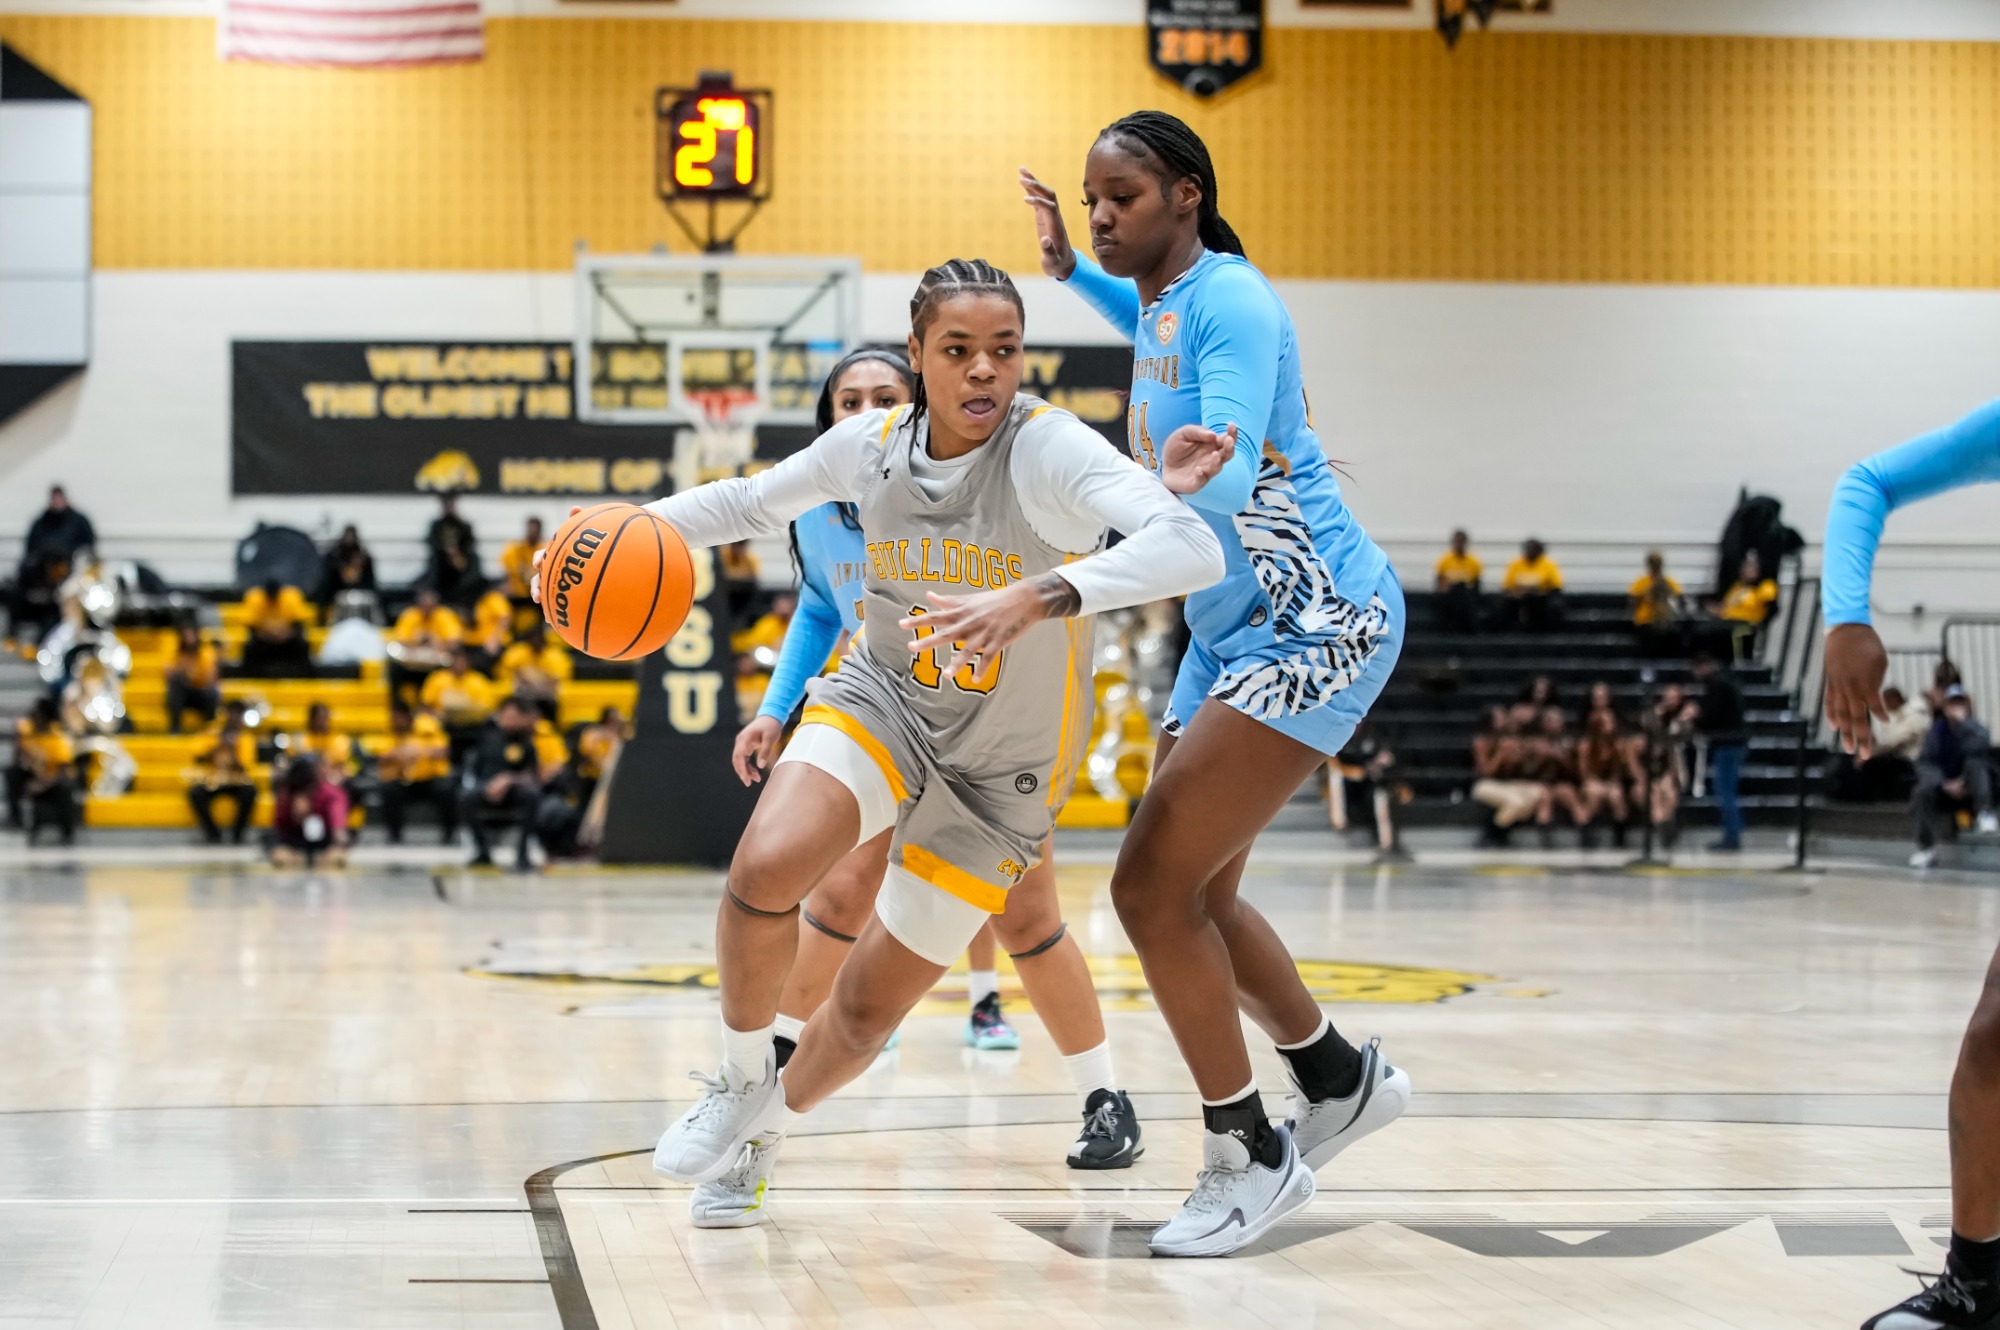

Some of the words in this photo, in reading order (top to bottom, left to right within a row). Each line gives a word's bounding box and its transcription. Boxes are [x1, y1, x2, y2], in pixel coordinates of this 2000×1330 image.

[364, 346, 548, 382] WELCOME
[303, 382, 379, 418] THE
[382, 382, 521, 419] OLDEST
[501, 458, 605, 493] HOME
[609, 458, 662, 493] OF
[554, 527, 608, 628] Wilson
[867, 537, 1022, 591] BULLDOGS
